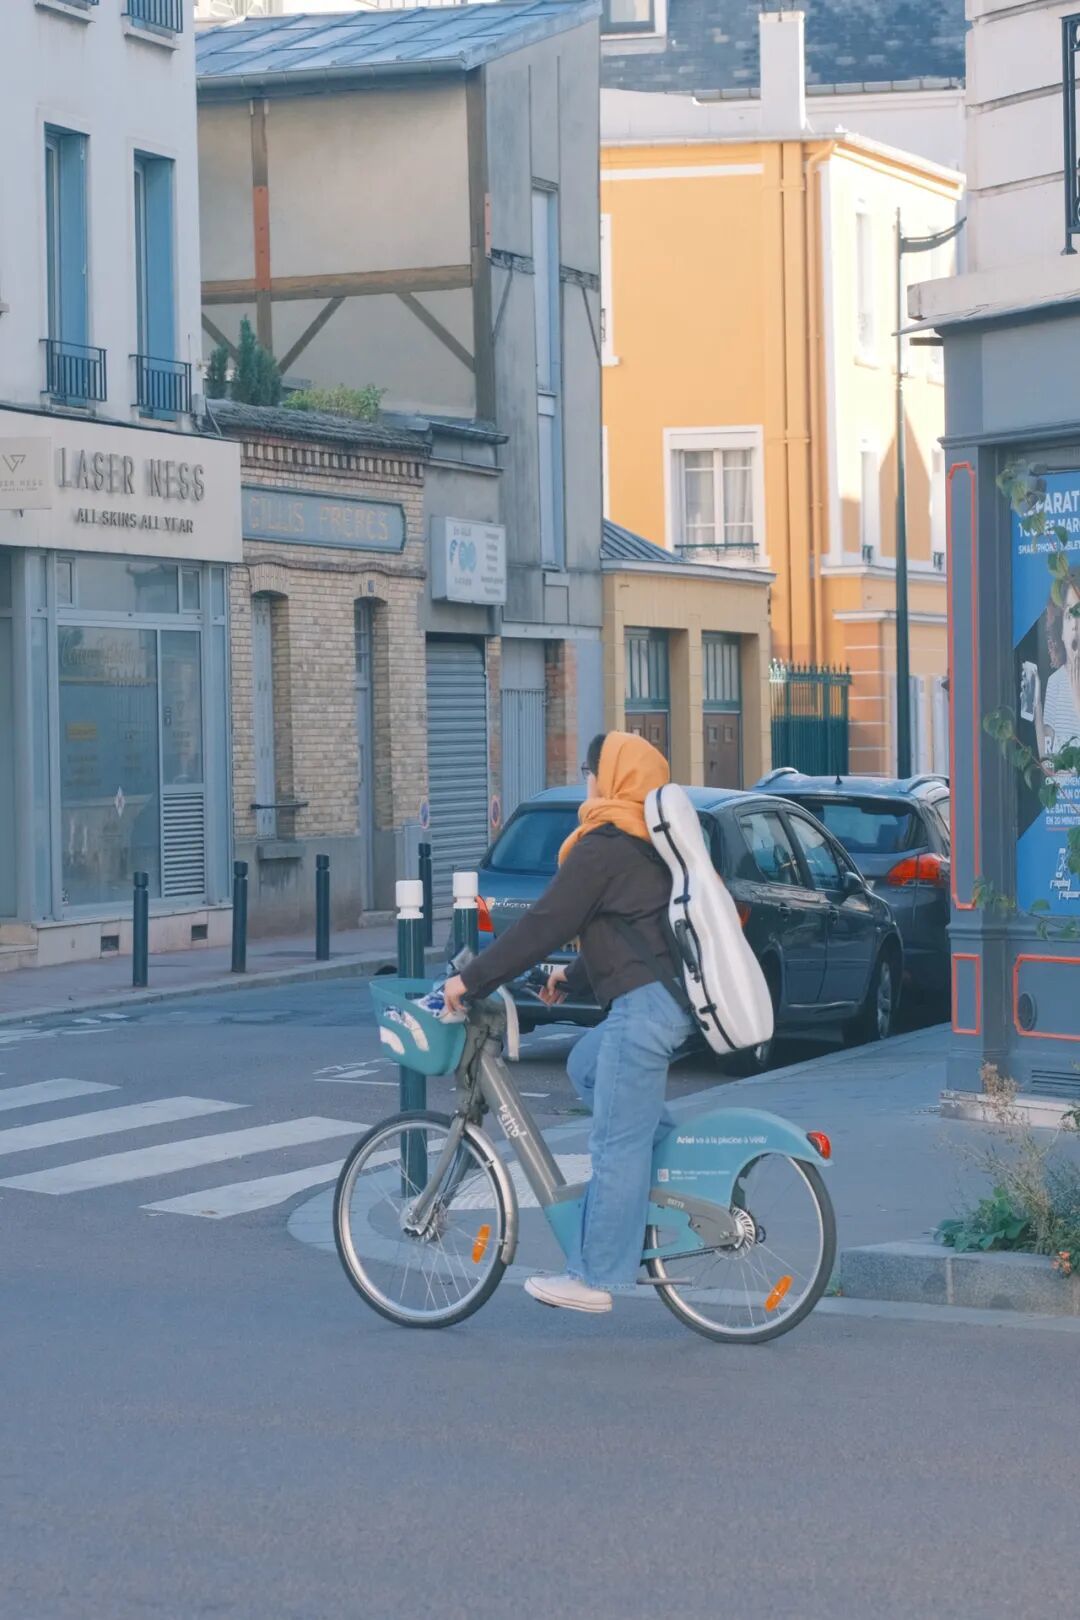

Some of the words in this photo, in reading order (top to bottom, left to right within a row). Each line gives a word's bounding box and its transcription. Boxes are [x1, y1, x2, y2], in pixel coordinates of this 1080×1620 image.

[58, 448, 135, 495] LASER
[148, 458, 205, 501] NESS
[76, 508, 97, 525] ALL
[102, 510, 137, 529] SKINS
[141, 514, 159, 530] ALL
[164, 516, 194, 534] YEAR
[676, 1135, 694, 1144] Ariel
